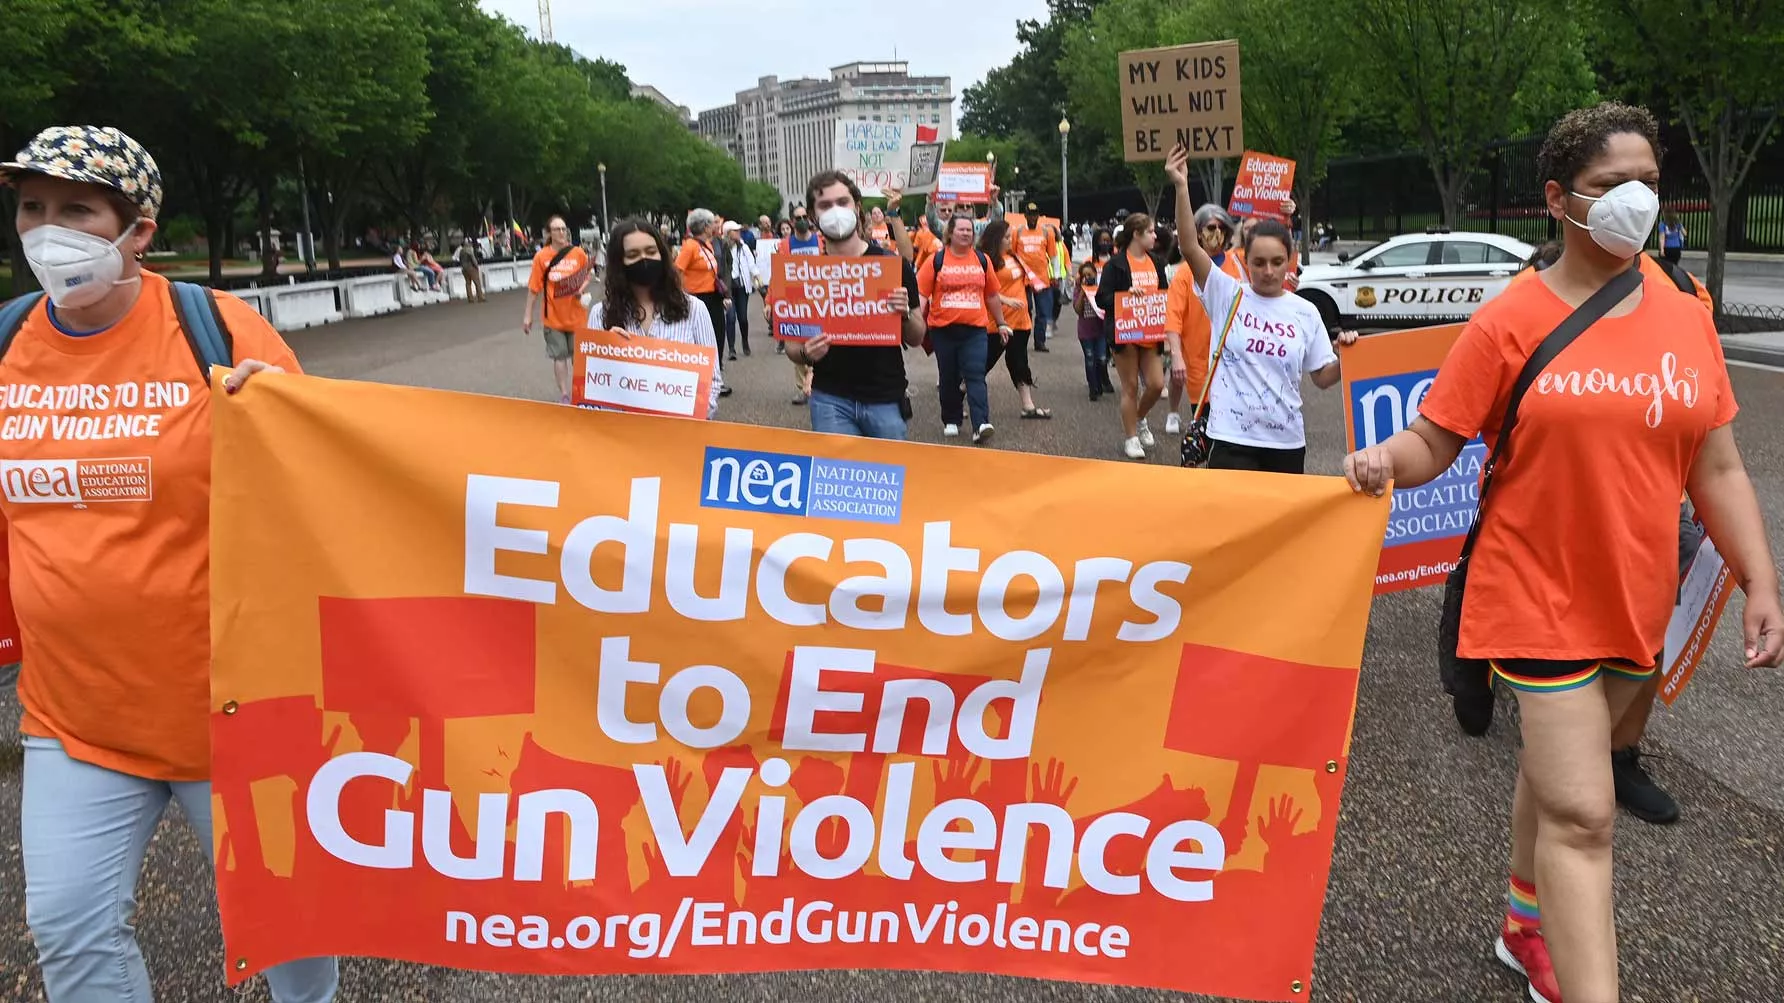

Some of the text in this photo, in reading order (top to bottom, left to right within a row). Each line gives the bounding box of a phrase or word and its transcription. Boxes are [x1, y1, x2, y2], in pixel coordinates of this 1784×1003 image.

[1129, 56, 1226, 84] MY KIDS
[1132, 89, 1227, 115] WILL NOT
[845, 122, 901, 139] HARDEN
[1136, 126, 1234, 152] BE NEXT
[846, 140, 899, 151] GUN LAWS
[859, 153, 885, 168] NOT
[1246, 157, 1289, 174] Educators
[1252, 172, 1281, 187] to End
[1233, 184, 1252, 199] Gun
[784, 261, 882, 281] Educators
[804, 278, 865, 300] to End
[1381, 288, 1484, 304] POLICE
[774, 296, 892, 319] Gun Violenc
[1122, 292, 1167, 308] Educator
[1132, 306, 1144, 317] to
[780, 323, 801, 336] nea
[1116, 314, 1166, 331] Gun Viole
[1244, 312, 1296, 338] CLASS
[580, 341, 709, 366] #ProtectOurSchools
[1246, 338, 1287, 358] 2026
[114, 382, 138, 408] TO
[144, 382, 190, 408] END
[587, 372, 693, 398] NOT ONE MORE
[1537, 352, 1699, 428] enough
[1, 414, 162, 440] GUN VIOLENCE
[80, 462, 145, 475] NATIONAL
[816, 465, 899, 486] NATIONAL
[6, 466, 75, 497] nea
[82, 475, 146, 486] EDUCATION
[705, 457, 802, 509] nea
[85, 486, 146, 497] ASSOCIATION
[815, 482, 898, 502] EDUCATION
[813, 499, 896, 517] ASSOCIATION
[1385, 509, 1473, 540] SSOCIATI
[464, 474, 1192, 642] Educators
[1663, 566, 1730, 697] rotectOurSchools
[597, 636, 1051, 760] to End
[306, 752, 1226, 902] Gun Violence
[445, 898, 1130, 959] nea.org/EndGunViolence
